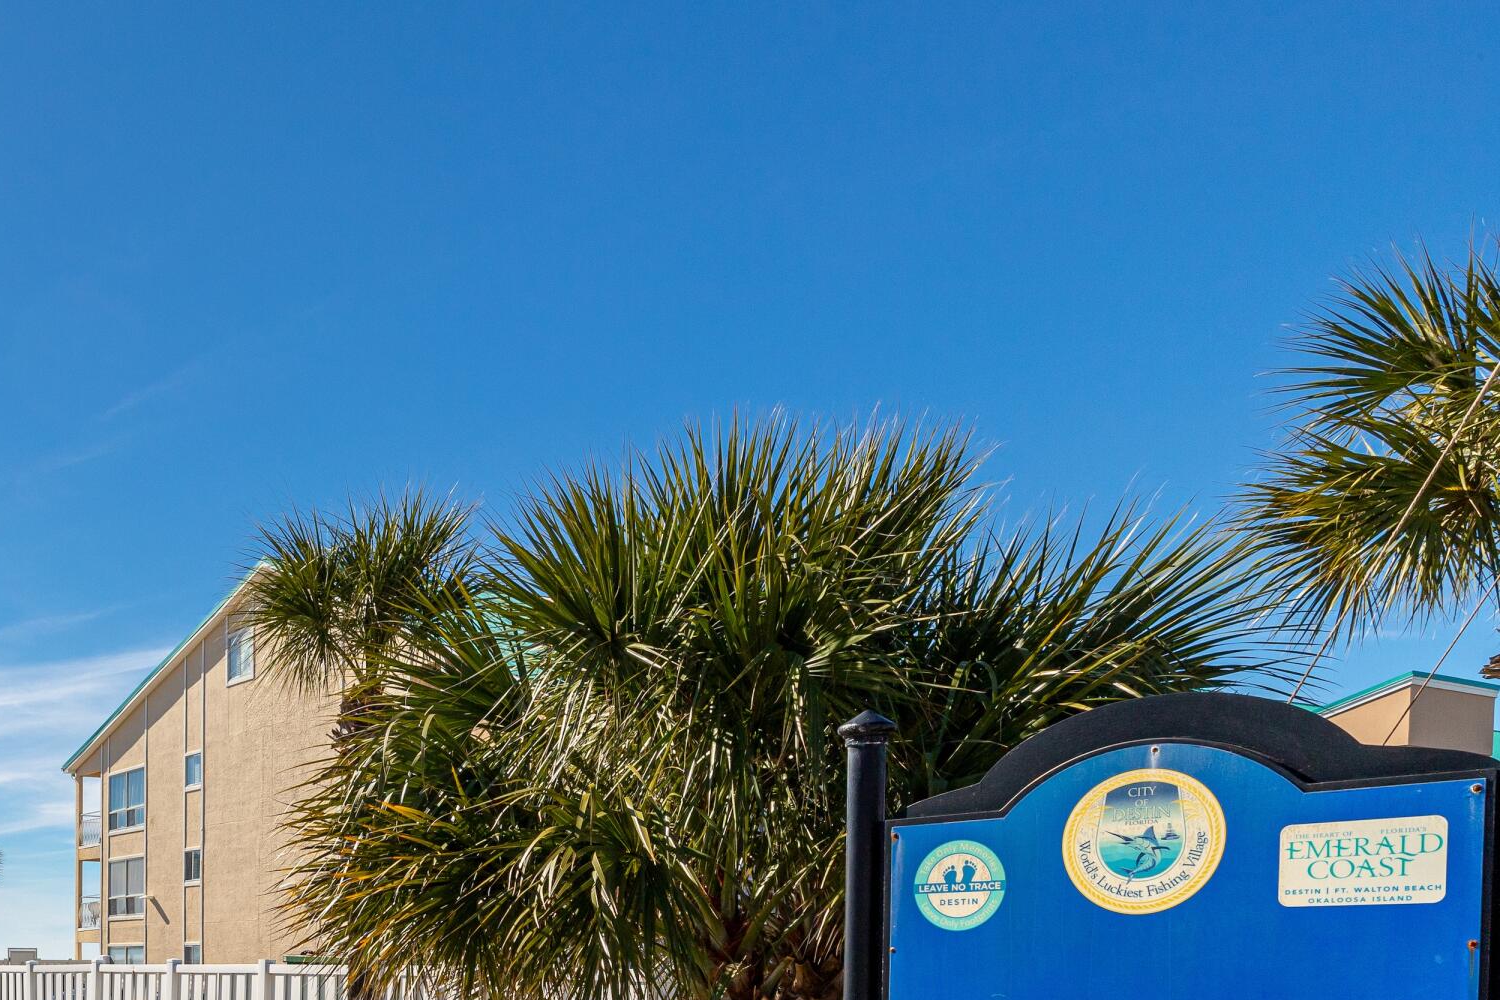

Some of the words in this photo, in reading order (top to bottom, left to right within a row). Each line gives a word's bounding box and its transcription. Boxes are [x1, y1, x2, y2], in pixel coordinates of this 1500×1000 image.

[1128, 786, 1157, 797] CITY
[1135, 799, 1148, 807] OF
[1111, 806, 1171, 822] DESTIN
[1285, 833, 1444, 860] EMERALD
[1079, 840, 1098, 880] World's
[1097, 876, 1143, 898] Luckiest
[1146, 870, 1191, 898] Fishing
[1182, 831, 1208, 868] Village
[1307, 856, 1415, 880] COAST
[918, 884, 949, 893] LEAVE
[951, 883, 966, 891] NO
[969, 882, 1001, 890] TRACE
[1354, 885, 1399, 893] WALTON
[1404, 884, 1442, 892] BEACH
[939, 898, 978, 906] DESTIN
[1308, 896, 1366, 904] OKALOOSA
[1372, 895, 1413, 903] ISLAND
